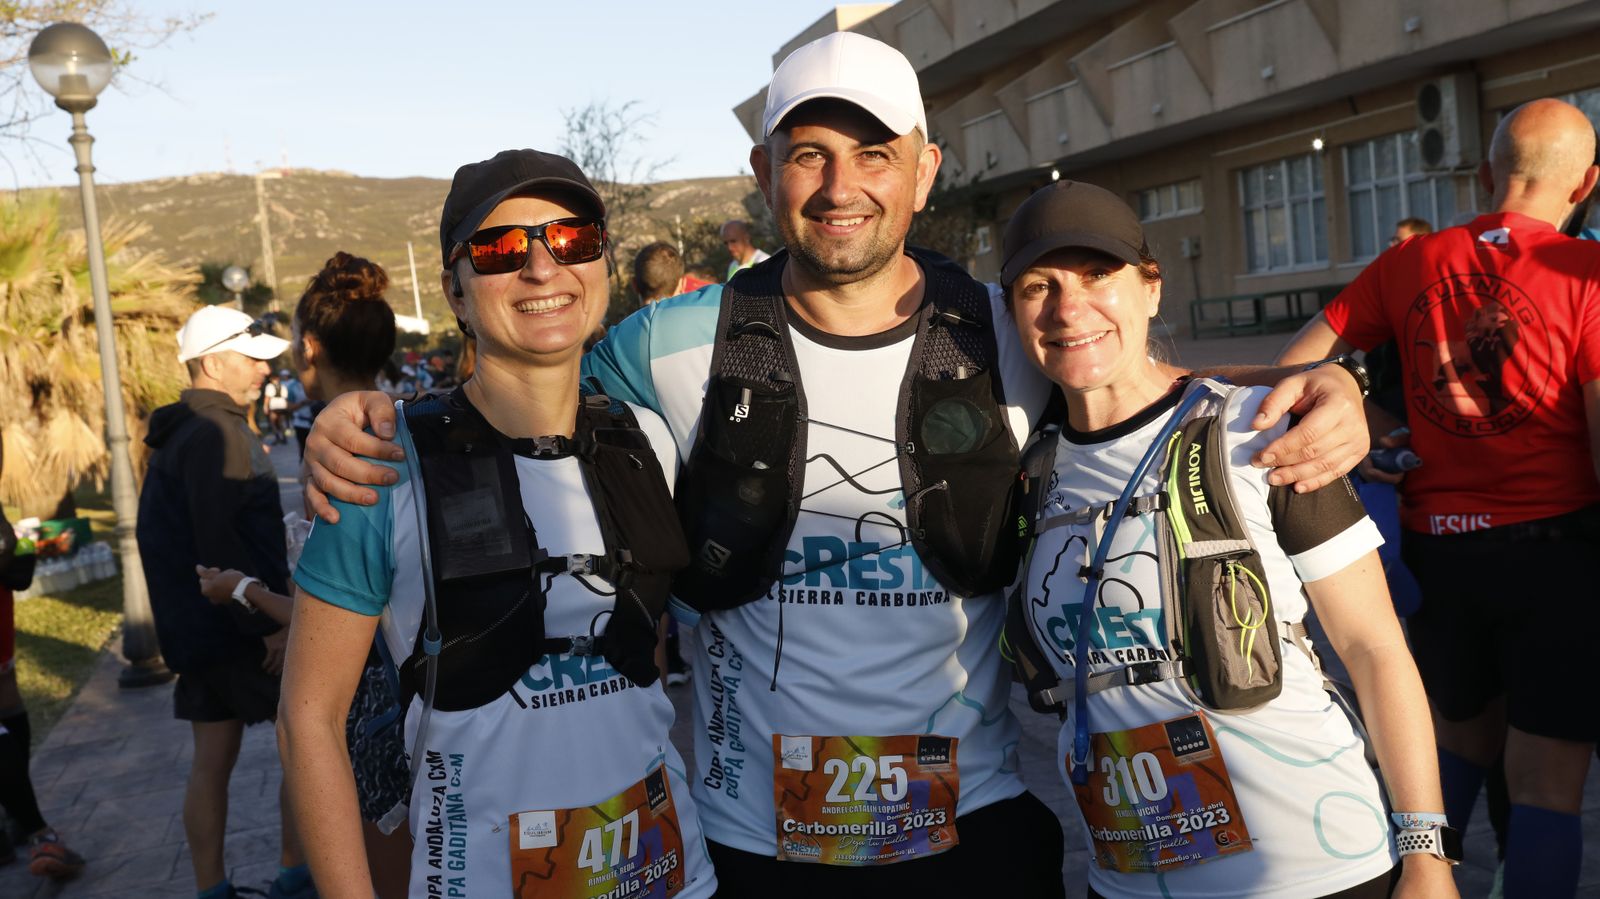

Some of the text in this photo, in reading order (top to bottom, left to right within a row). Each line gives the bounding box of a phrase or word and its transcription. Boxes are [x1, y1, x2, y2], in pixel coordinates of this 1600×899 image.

[1415, 278, 1535, 326] RUNNING
[1456, 383, 1540, 432] ROQUE
[1188, 442, 1210, 515] AONIJIE
[779, 589, 950, 607] SIERRA CARBONERA
[531, 687, 586, 709] SIERRA
[723, 757, 745, 800] COPA
[823, 755, 908, 803] 225
[1101, 751, 1168, 807] 310
[783, 811, 947, 836] Carbonerilla 2023
[822, 806, 848, 814] ANDREI
[1090, 809, 1231, 842] Carbonerilla 2023
[1137, 805, 1160, 817] VICKY
[1196, 805, 1206, 813] de
[1207, 801, 1224, 811] abril
[425, 785, 447, 869] ANDALUZA
[446, 793, 468, 871] GADITANA
[577, 808, 639, 874] 477
[619, 862, 635, 876] REDA
[645, 854, 678, 885] 2023
